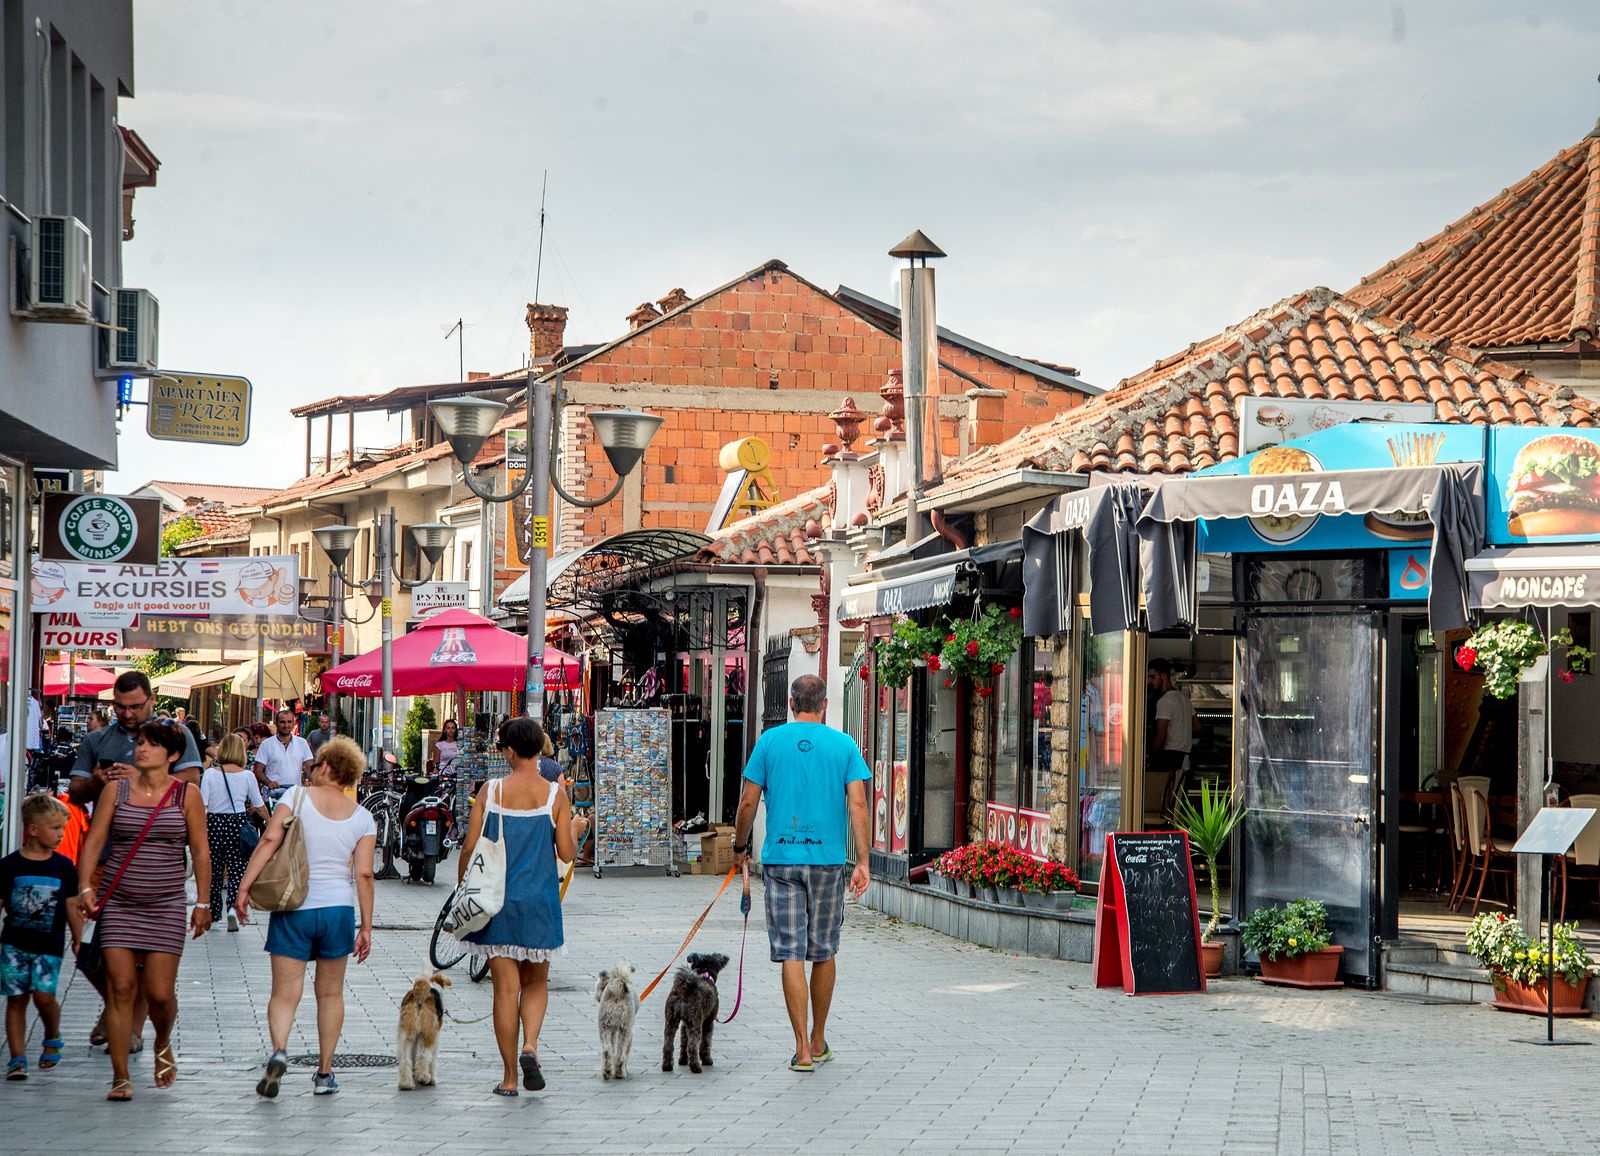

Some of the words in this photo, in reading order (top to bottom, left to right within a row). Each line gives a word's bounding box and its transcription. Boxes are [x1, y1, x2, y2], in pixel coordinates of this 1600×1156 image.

[157, 386, 243, 403] APARTMEN
[180, 401, 240, 422] PLAZA
[1250, 480, 1346, 513] OAZA
[66, 500, 101, 530] COFFE
[104, 501, 132, 532] SHOP
[1065, 495, 1090, 527] OAZA
[535, 521, 547, 543] 3511
[77, 543, 121, 559] MINAS
[118, 560, 188, 577] ALEX
[77, 581, 227, 598] EXCURSIES
[1499, 573, 1588, 599] MONCAFÉ
[93, 601, 125, 611] Dagje
[127, 601, 141, 609] uit
[143, 601, 170, 611] goed
[883, 587, 903, 611] OAZA
[147, 620, 188, 633] HEBT
[193, 621, 224, 634] ONS
[228, 622, 317, 636] GEVONDEN!
[43, 631, 119, 646] TOURS
